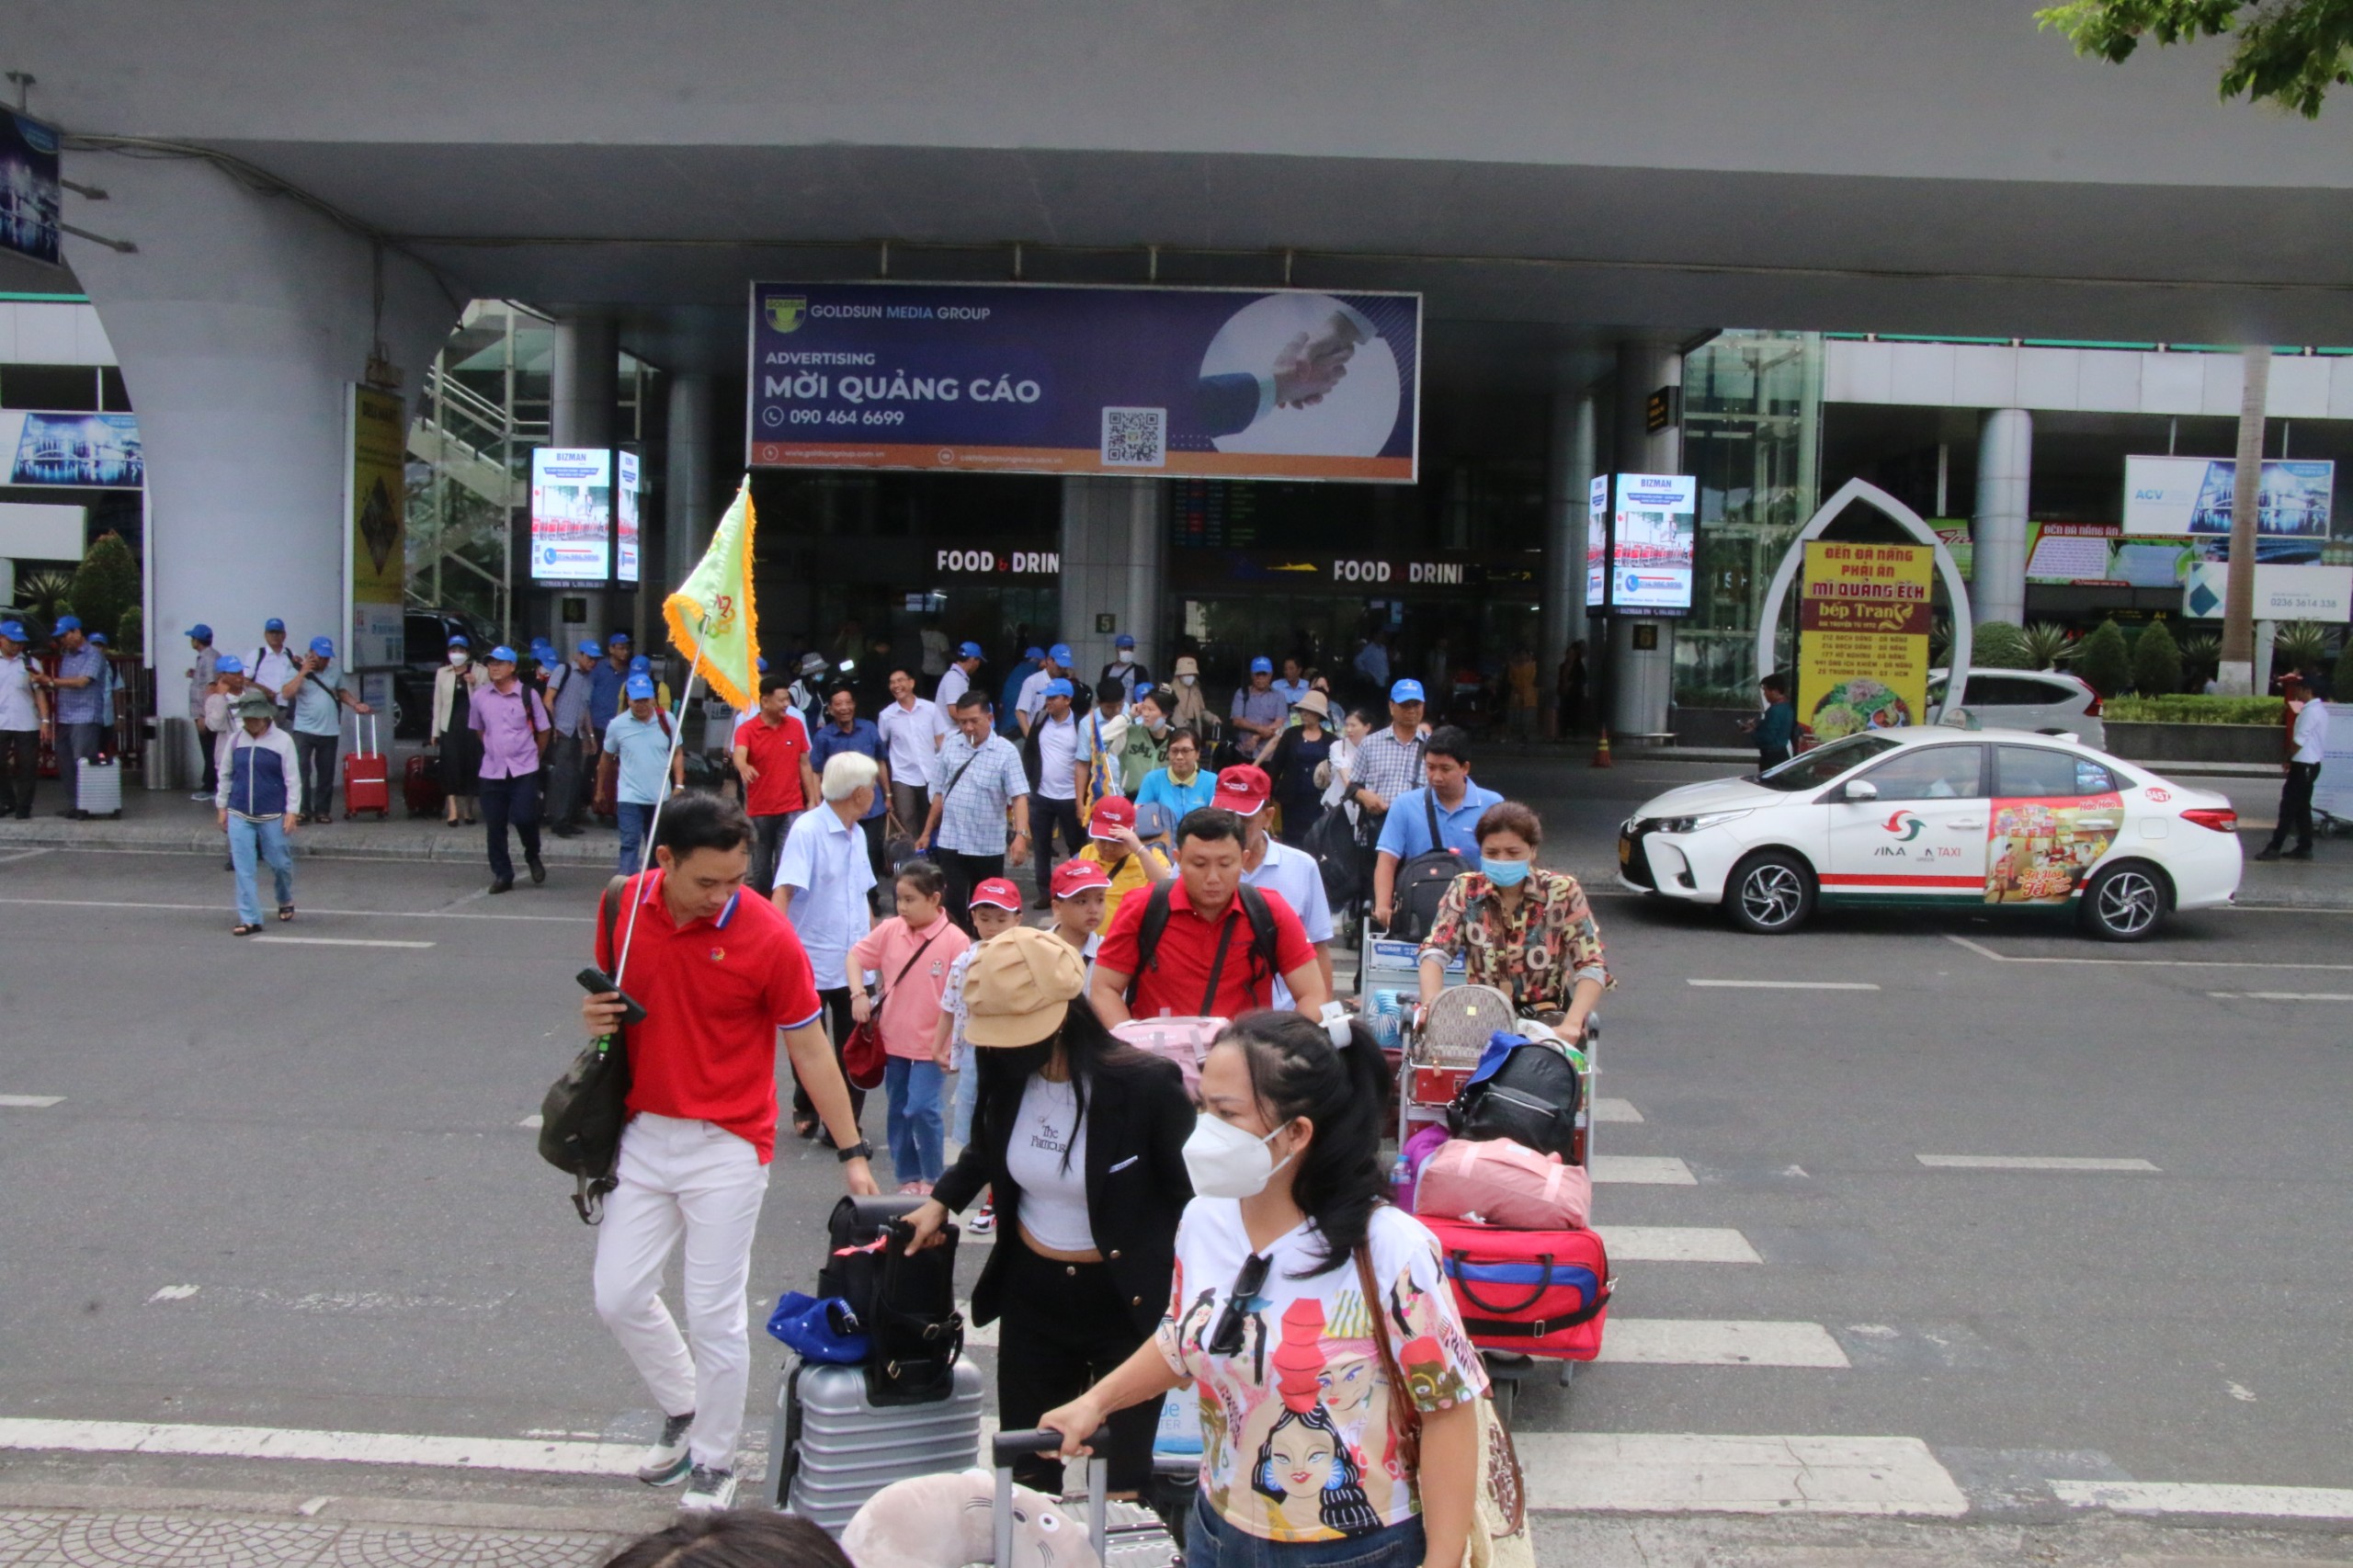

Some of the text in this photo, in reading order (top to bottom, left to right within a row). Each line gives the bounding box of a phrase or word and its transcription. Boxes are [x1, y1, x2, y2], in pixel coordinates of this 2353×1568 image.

[811, 305, 991, 320] GOLDSUN MEDIA GROUP
[765, 352, 876, 366] ADVERTISING
[764, 369, 1041, 403] MỜI QUẢNG CÁO
[790, 410, 904, 426] 090 464 6699
[556, 453, 586, 461] BIZMAN
[1641, 479, 1672, 488] BIZMAN
[2135, 490, 2164, 500] ACV
[937, 550, 995, 572] FOOD
[1334, 560, 1391, 582] FOOD
[1837, 577, 1893, 597] QUẢNG
[2270, 597, 2292, 607] 0236
[2296, 598, 2317, 608] 3614
[1819, 601, 1850, 619] bếp
[1100, 616, 1111, 631] 5
[2145, 790, 2170, 801] 5457
[1938, 847, 1961, 858] TAXI
[1041, 1125, 1059, 1139] The
[1030, 1135, 1067, 1153] Famous
[1159, 1419, 1181, 1430] TER
